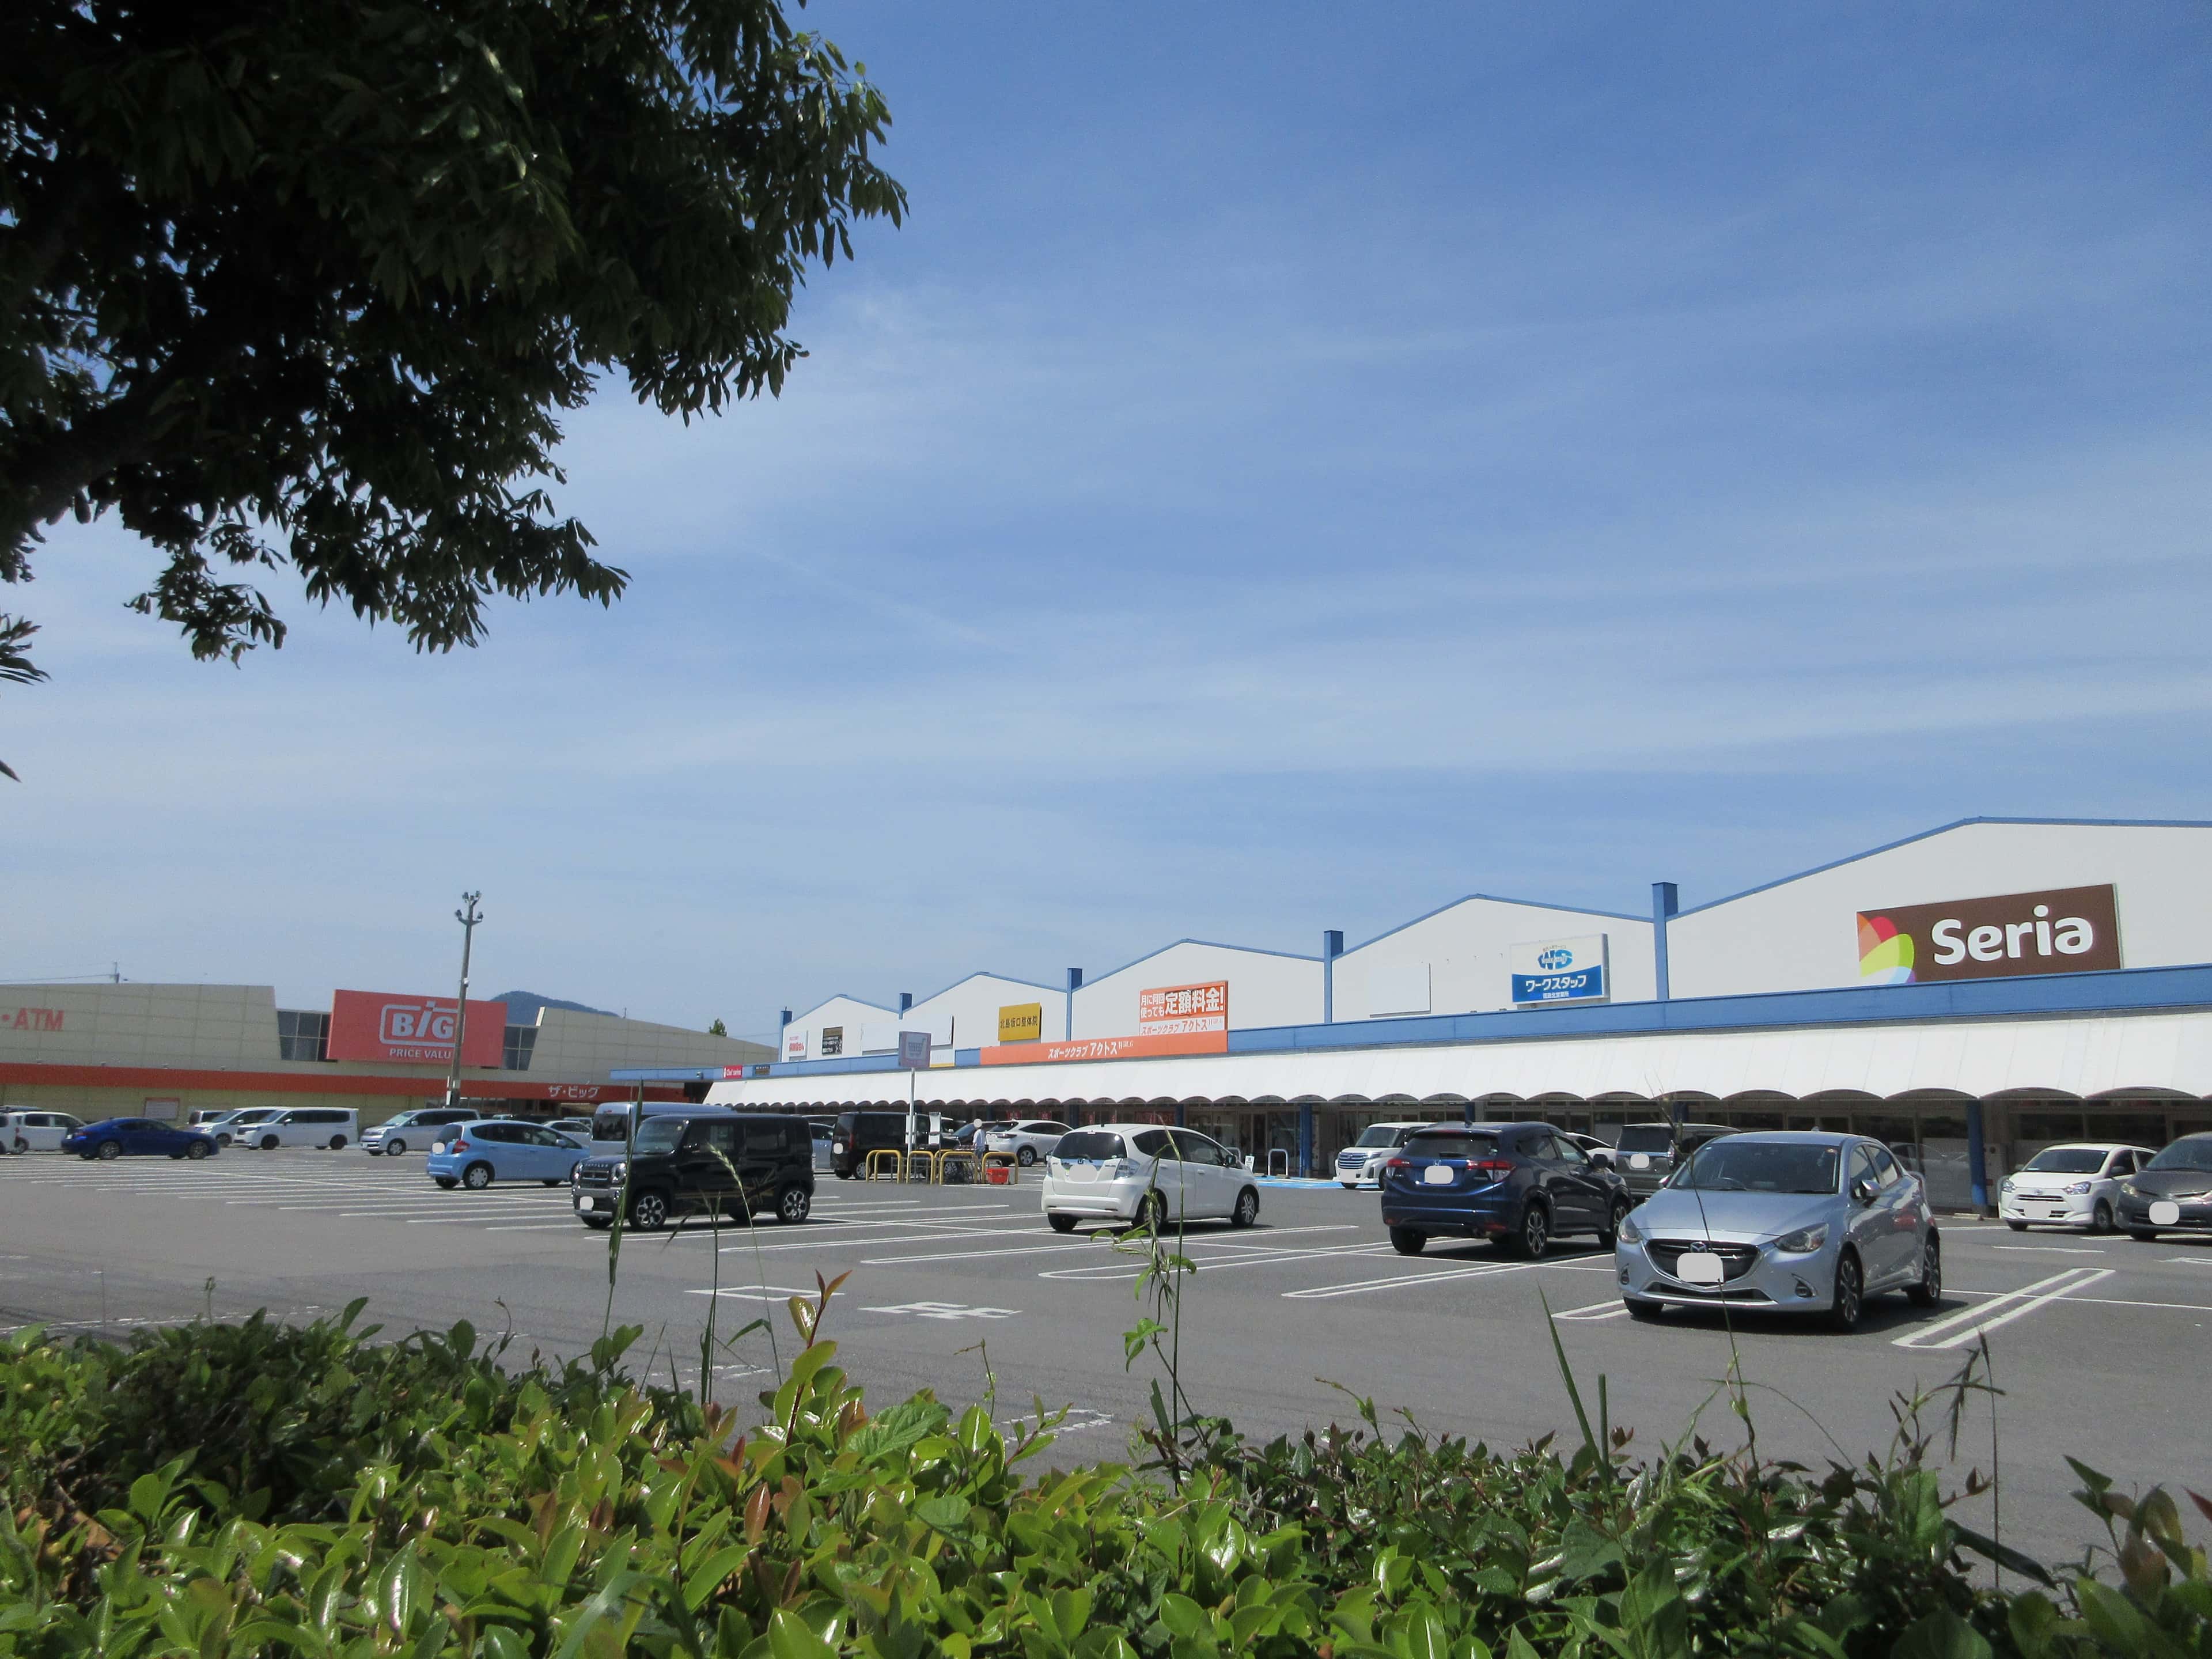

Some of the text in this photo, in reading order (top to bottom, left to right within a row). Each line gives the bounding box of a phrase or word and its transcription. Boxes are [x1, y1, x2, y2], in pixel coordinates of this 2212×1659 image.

[1931, 904, 2093, 965] Seria
[1525, 975, 1587, 993] ワークスタッフ
[1141, 1006, 1165, 1018] 使っても
[389, 1047, 452, 1059] PRICE VALU
[1048, 1046, 1089, 1059] スポーツクラブ
[1089, 1041, 1118, 1056] アクトス
